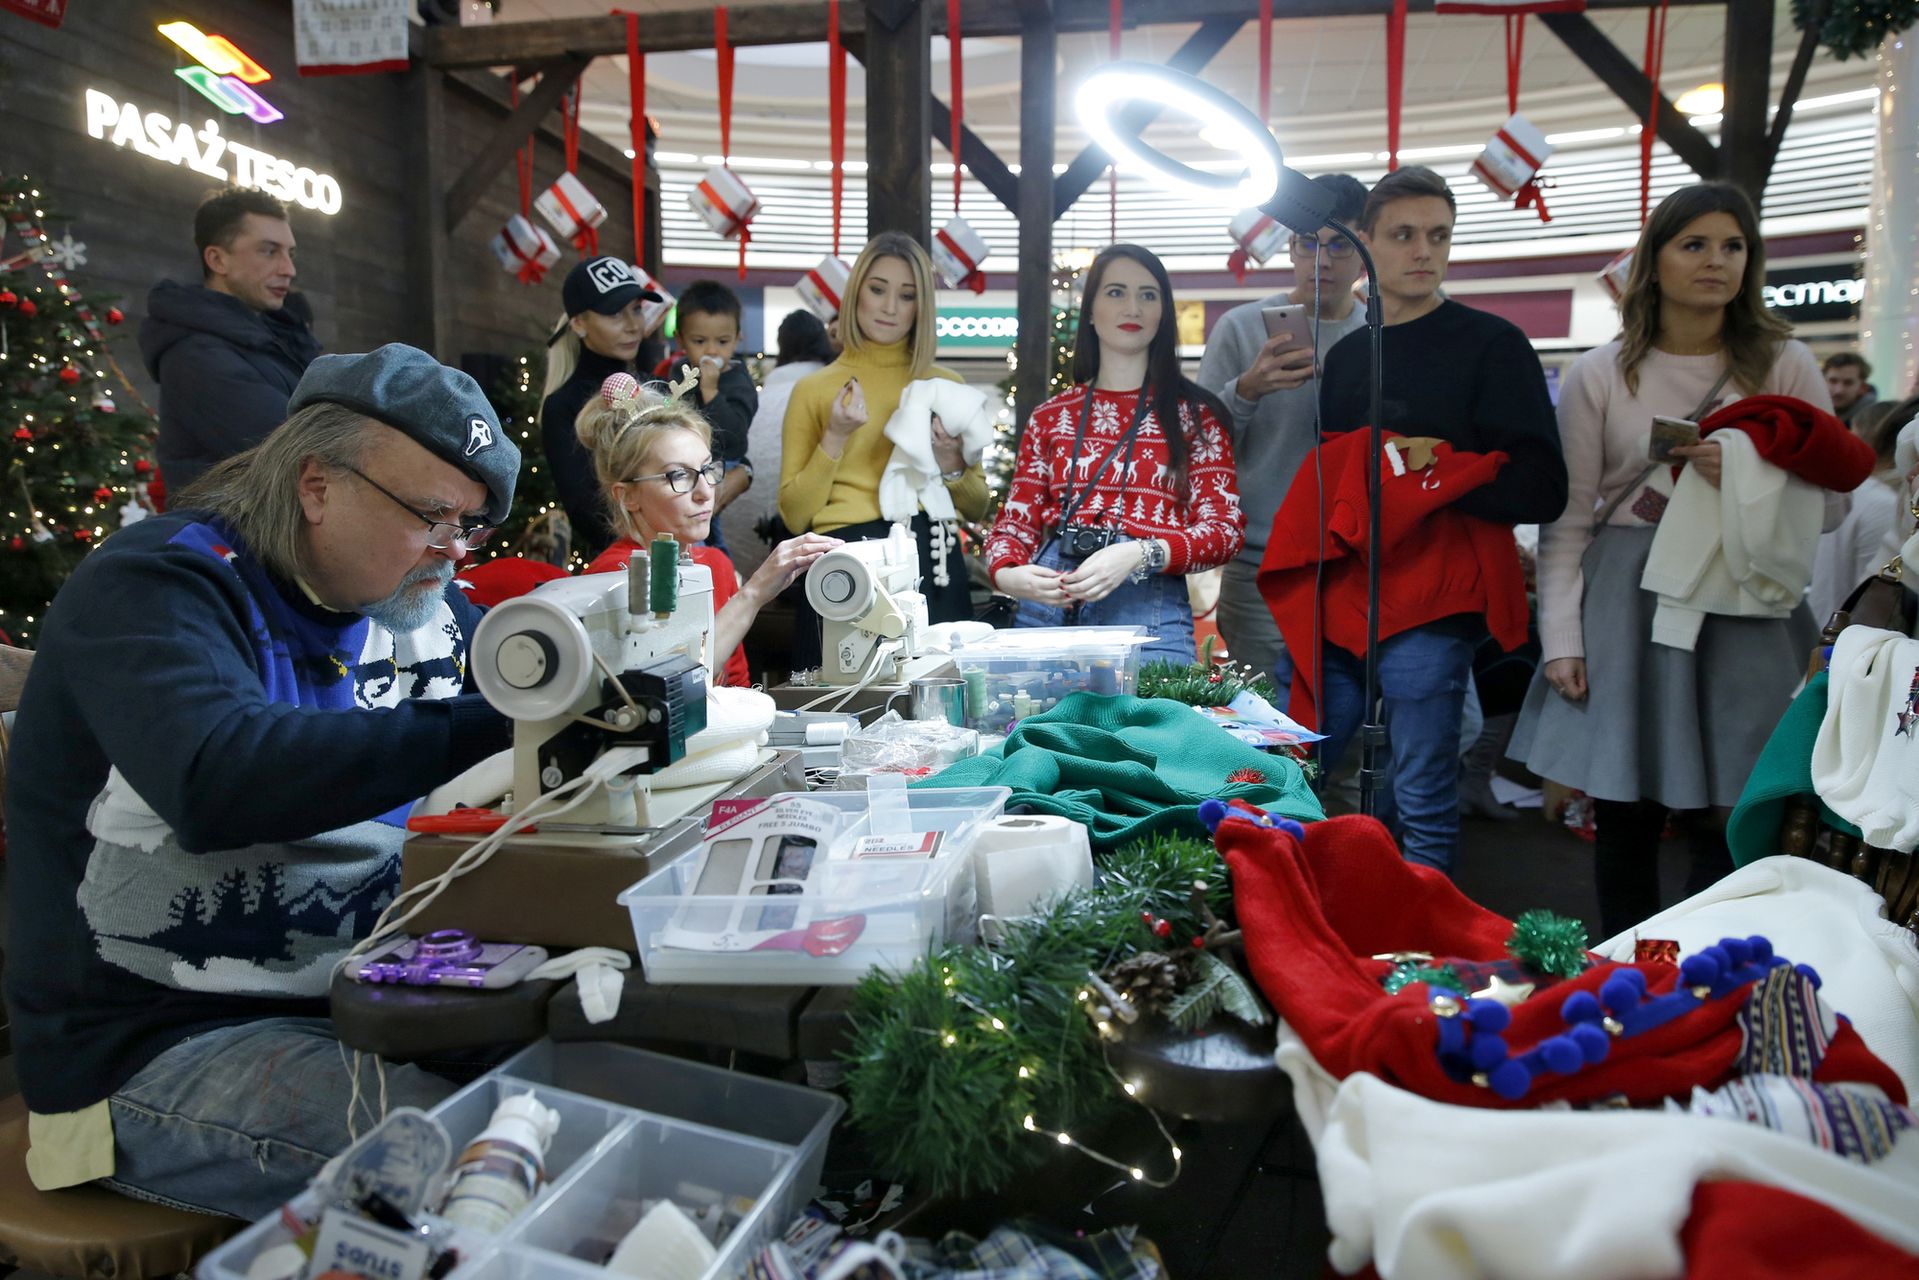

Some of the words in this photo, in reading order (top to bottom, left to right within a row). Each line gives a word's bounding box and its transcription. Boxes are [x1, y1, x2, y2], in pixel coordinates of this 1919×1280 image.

[85, 88, 228, 182] PASAŻ
[227, 140, 342, 215] TESCO
[718, 805, 738, 815] F4A
[758, 821, 778, 829] FREE
[788, 820, 822, 833] JUMBO
[864, 844, 914, 853] NEEDLES
